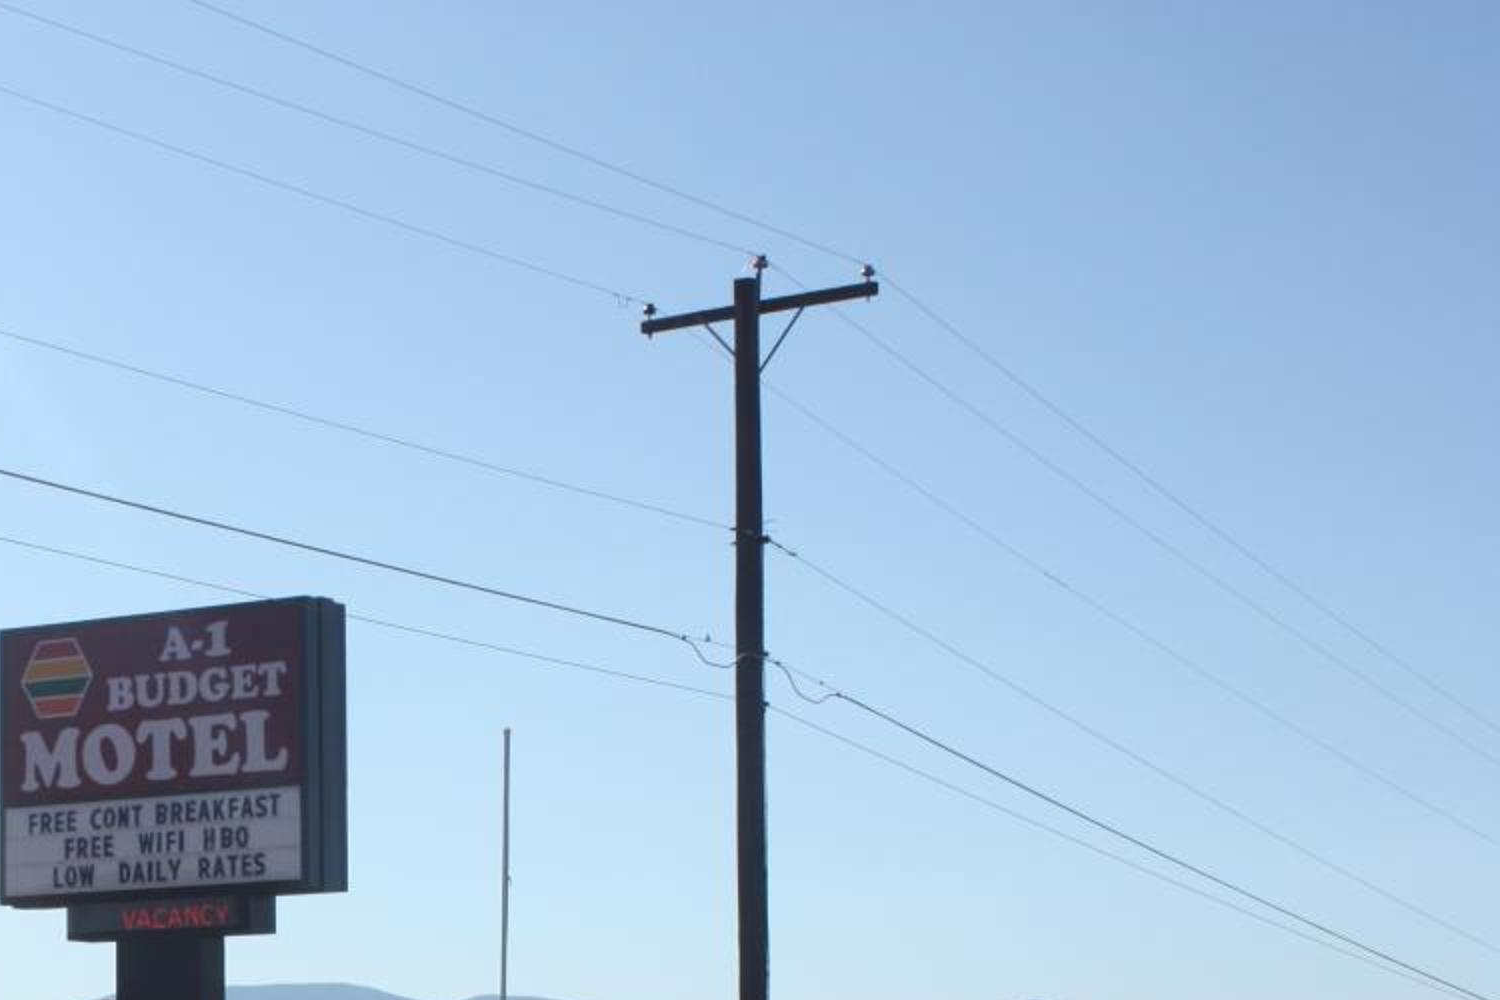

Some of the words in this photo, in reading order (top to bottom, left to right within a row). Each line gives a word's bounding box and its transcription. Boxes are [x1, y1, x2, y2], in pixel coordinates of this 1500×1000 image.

[159, 620, 231, 662] A-1
[106, 661, 287, 712] BUDGET
[20, 709, 288, 792] MOTEL
[28, 811, 77, 836] FREE
[90, 804, 143, 830] CONT
[155, 793, 282, 825] BREAKFAST
[64, 835, 114, 860] FREE
[139, 831, 185, 855] WIFI
[203, 827, 249, 851] HBO
[53, 864, 95, 889] LOW
[119, 859, 181, 884] DAILY
[199, 853, 266, 880] RATES
[121, 904, 229, 930] VACANCY
